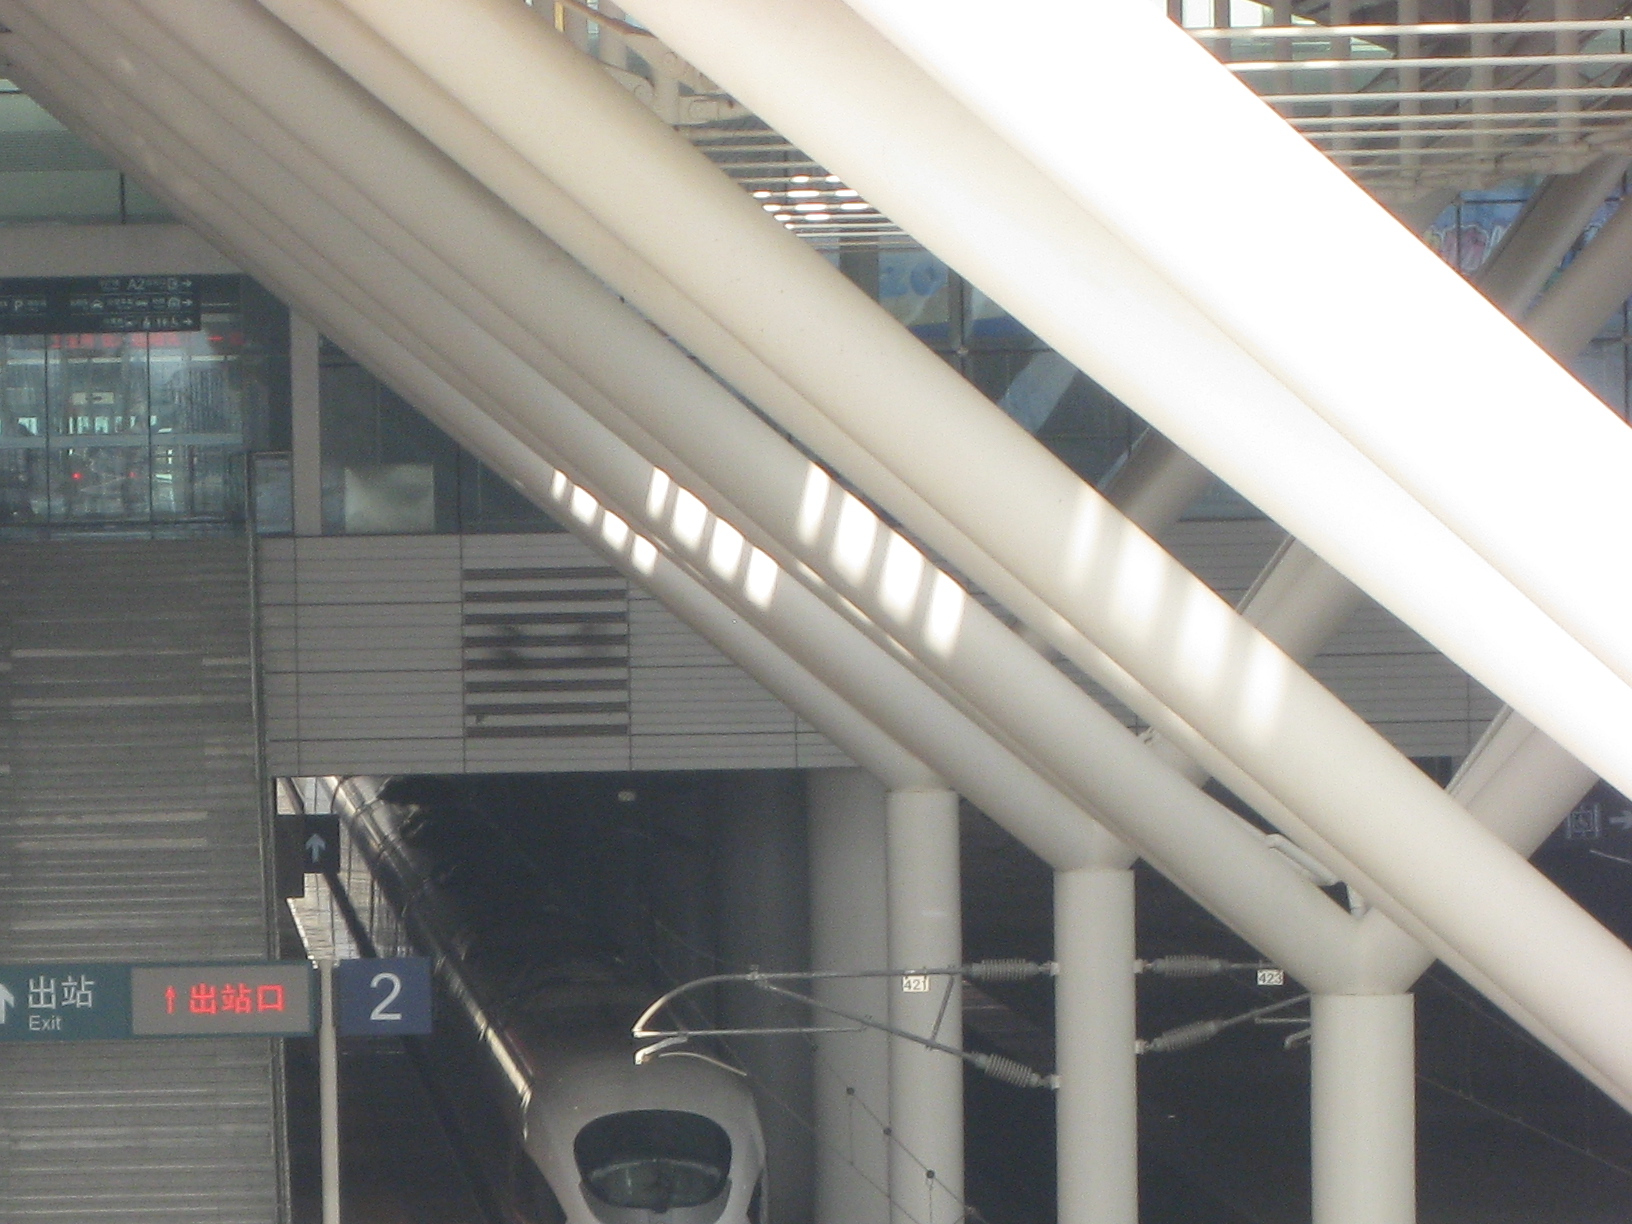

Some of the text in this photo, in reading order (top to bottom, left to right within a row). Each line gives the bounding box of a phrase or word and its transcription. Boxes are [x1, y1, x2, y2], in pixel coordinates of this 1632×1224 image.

[127, 279, 145, 290] A2
[903, 979, 927, 991] 421
[1258, 972, 1284, 984] 423
[28, 974, 95, 1009] 出站
[189, 983, 286, 1014] 出站口
[370, 973, 403, 1020] 2
[29, 1015, 62, 1031] Exit
